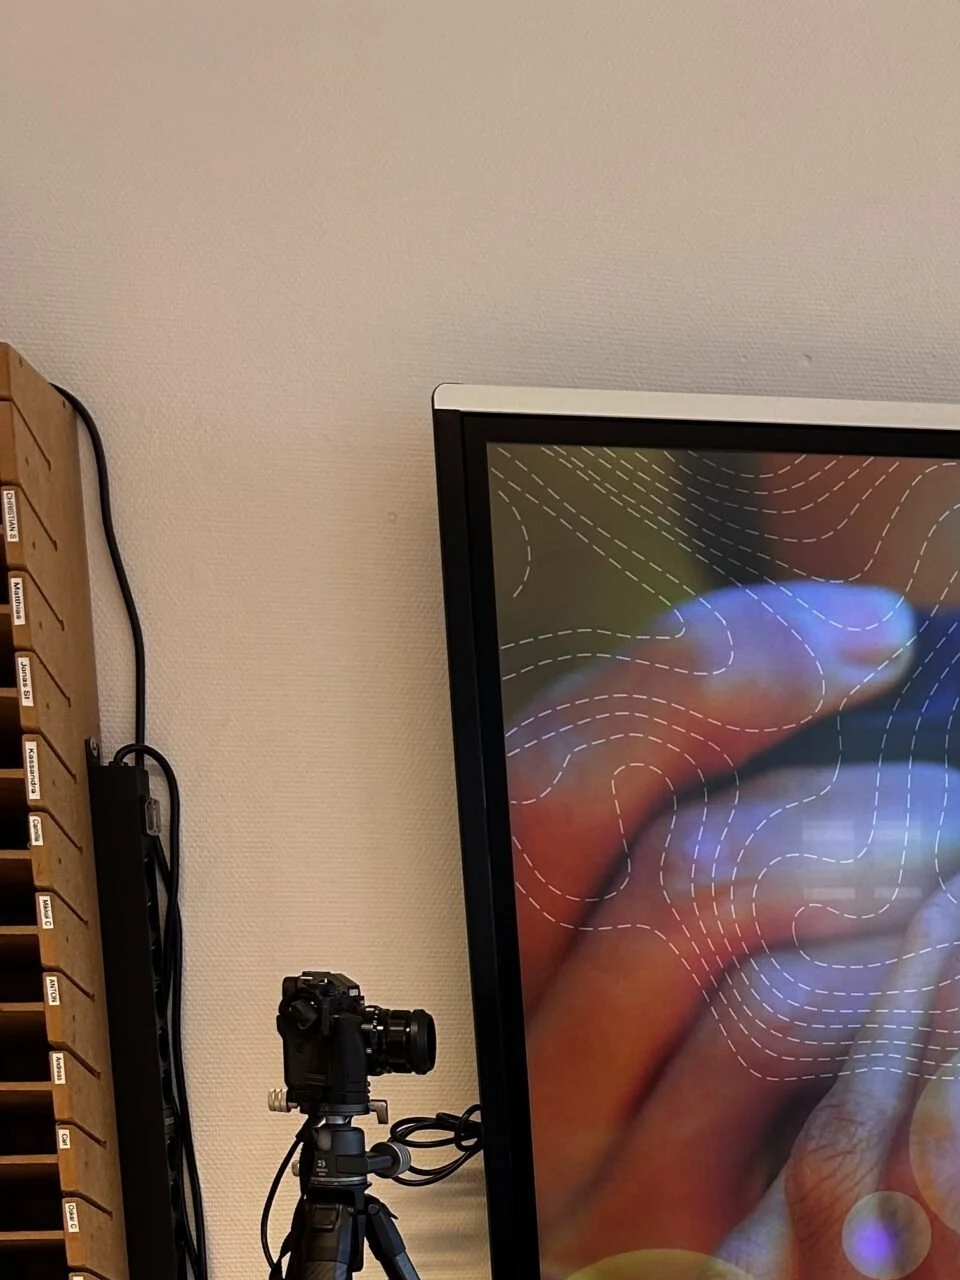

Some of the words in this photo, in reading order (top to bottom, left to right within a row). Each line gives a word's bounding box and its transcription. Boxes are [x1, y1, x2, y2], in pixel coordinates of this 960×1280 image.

[5, 492, 16, 532] CHRISTIAN
[13, 582, 22, 620] Matthias
[20, 662, 28, 688] Jonas
[28, 748, 37, 794] Kassandra
[49, 979, 58, 1003] ANTON
